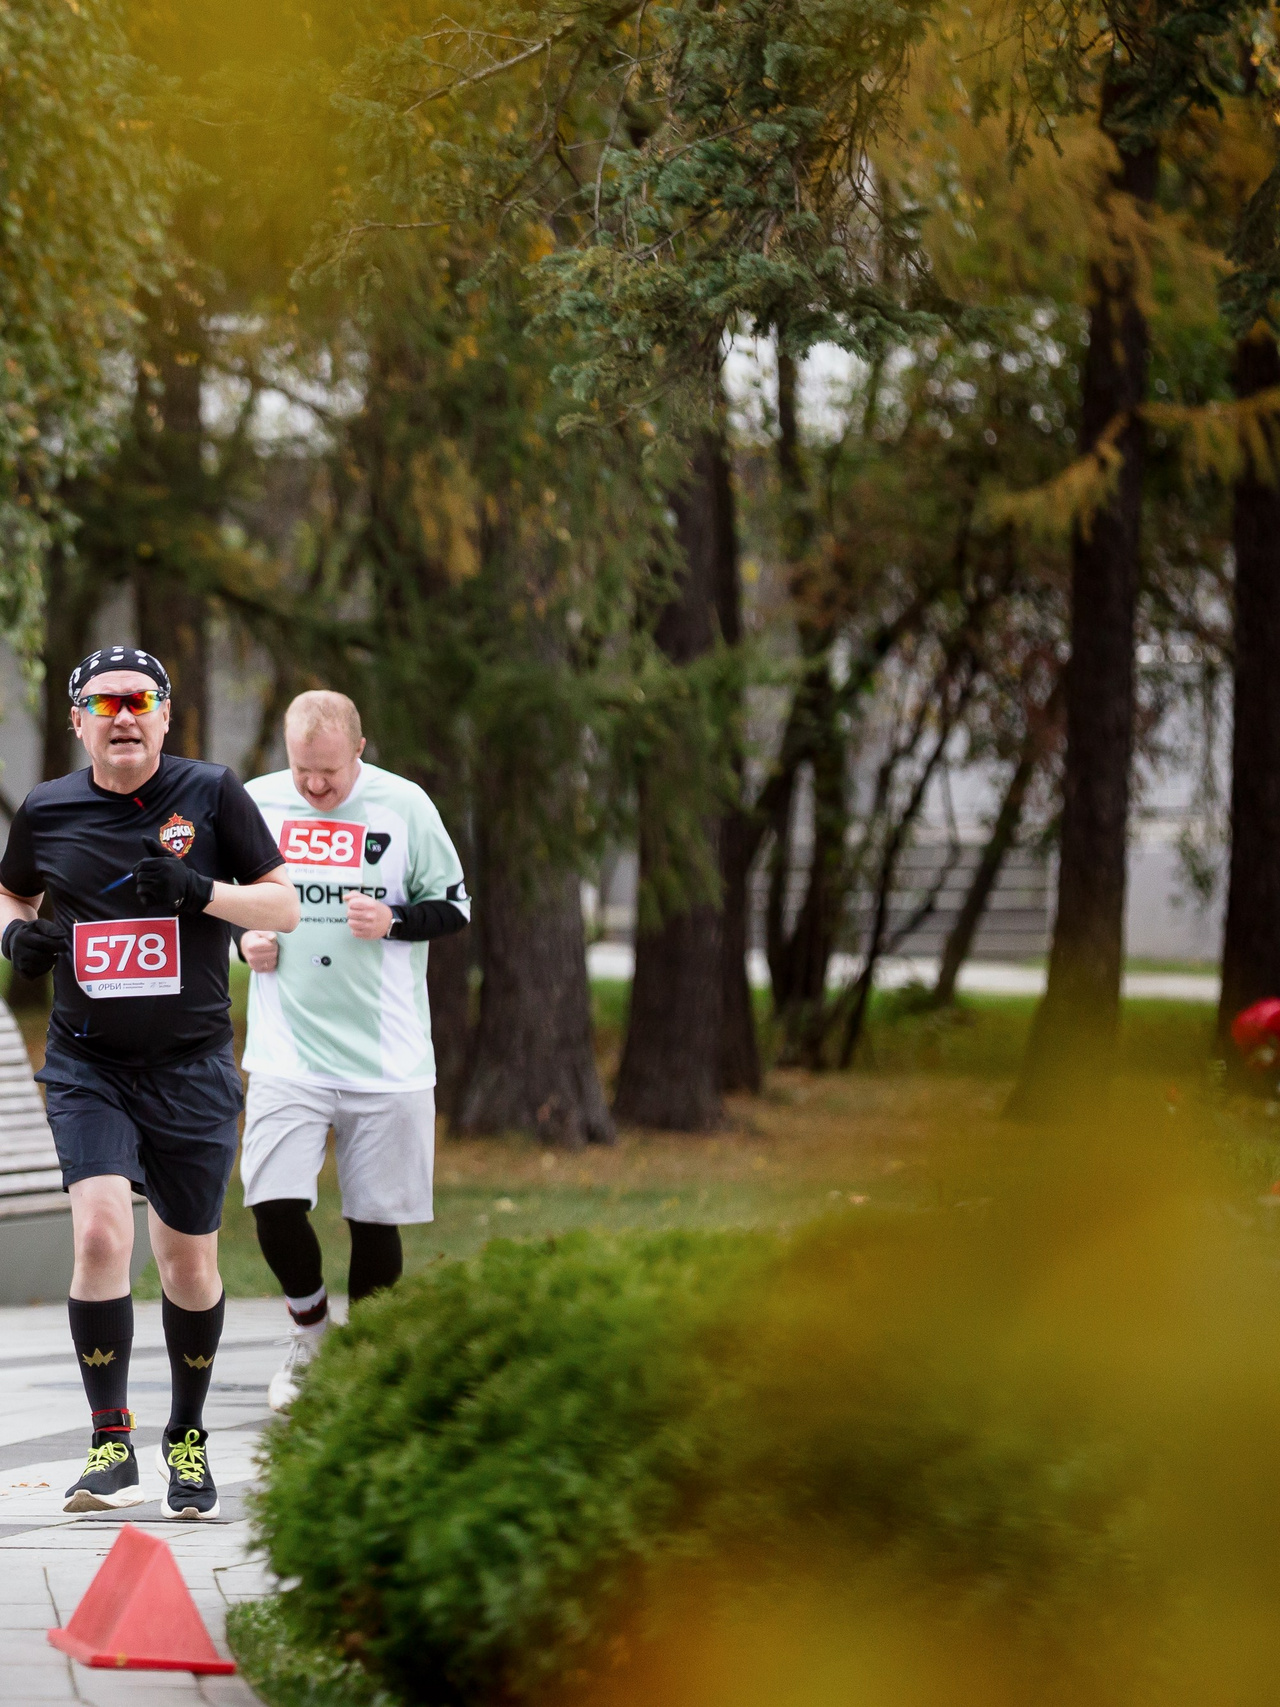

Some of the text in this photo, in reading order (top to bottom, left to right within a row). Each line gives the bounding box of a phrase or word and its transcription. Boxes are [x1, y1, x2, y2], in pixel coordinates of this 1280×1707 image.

[162, 825, 192, 841] ЦСКА
[284, 828, 354, 863] 558
[84, 933, 167, 973] 578
[98, 983, 122, 991] ОРБИ
